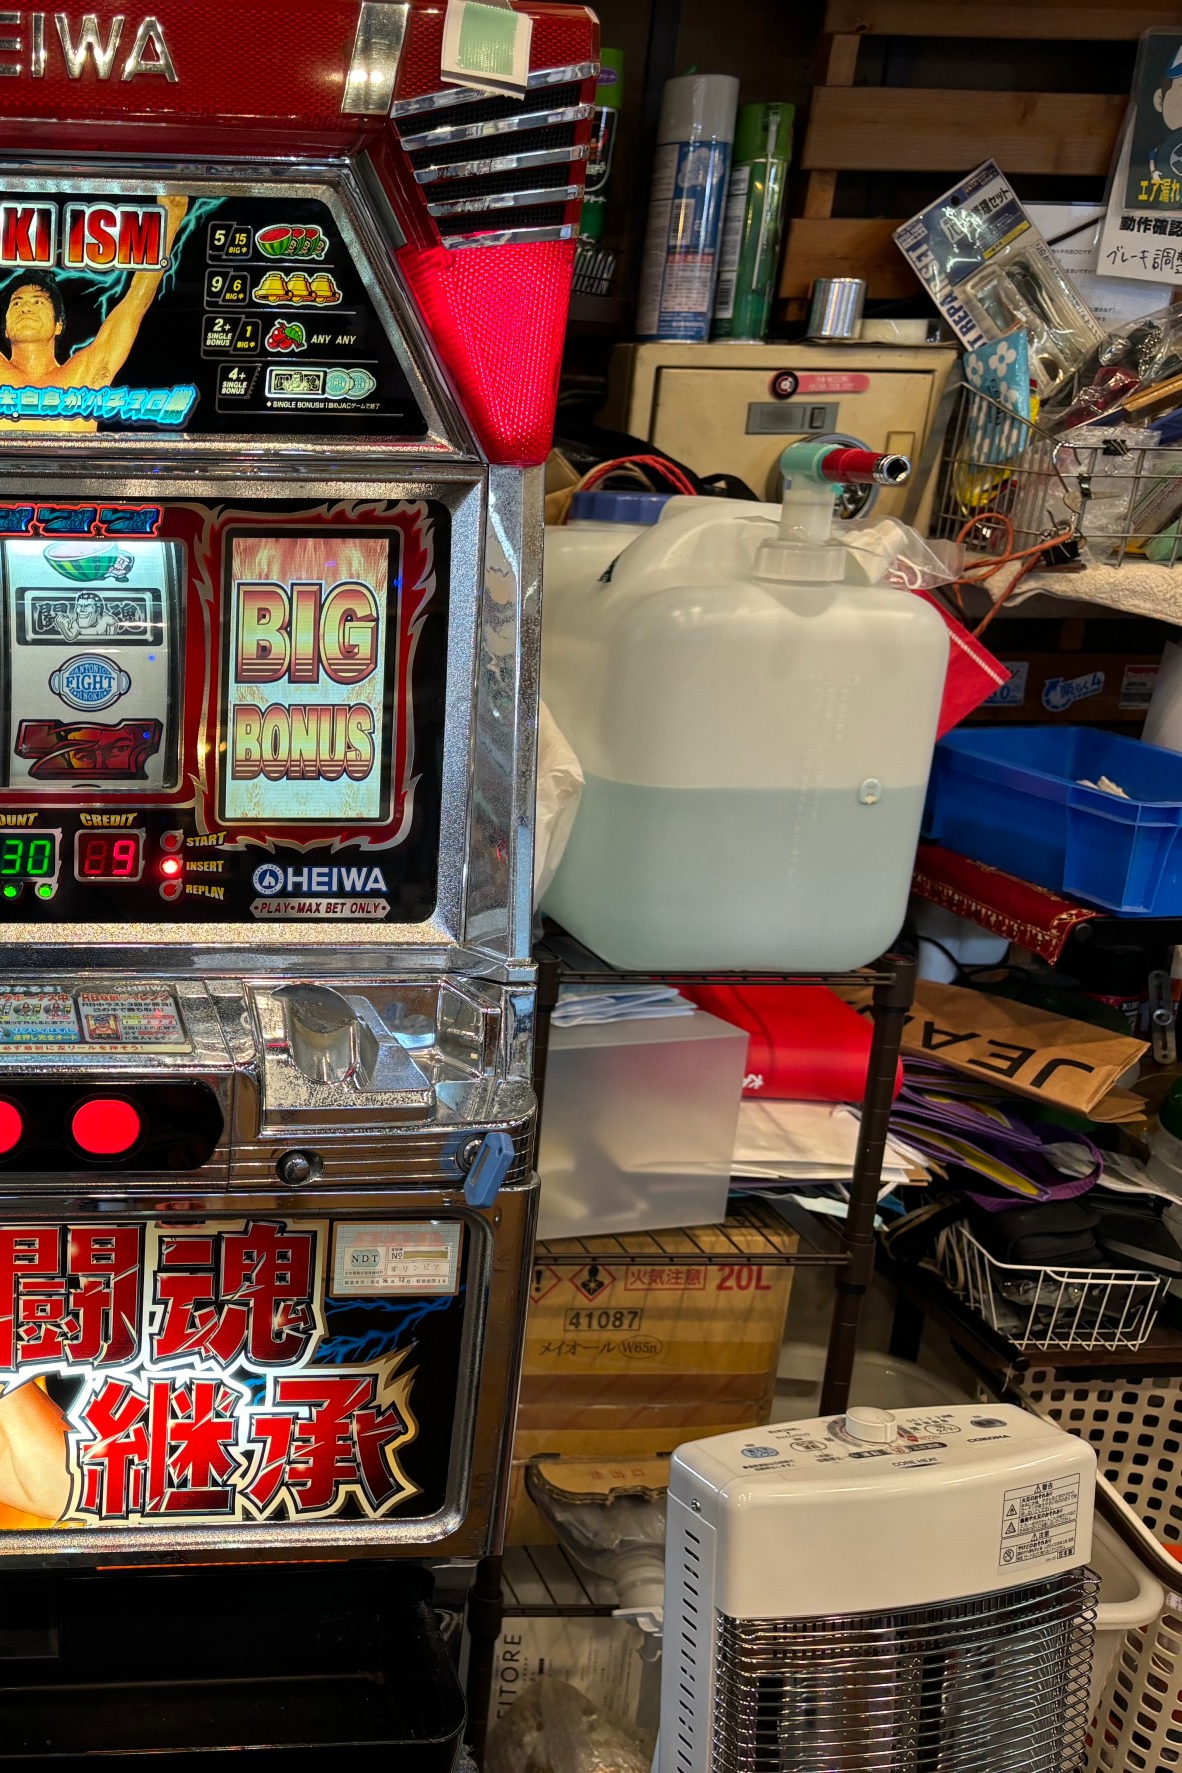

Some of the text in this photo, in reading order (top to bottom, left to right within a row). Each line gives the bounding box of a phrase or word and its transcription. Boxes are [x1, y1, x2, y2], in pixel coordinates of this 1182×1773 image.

[1138, 178, 1182, 202] エア漏れ
[68, 208, 160, 266] ISM
[214, 230, 226, 246] 5
[234, 233, 247, 245] 15
[211, 276, 223, 292] 9
[233, 280, 242, 291] 6
[245, 326, 252, 338] 1
[310, 335, 357, 344] ANY ANY
[206, 339, 230, 347] BONUS
[221, 387, 245, 395] BONUS
[222, 381, 247, 389] SINGLE
[235, 581, 379, 685] BIG
[72, 662, 110, 674] ANTONIO
[65, 674, 116, 691] FIGHT
[232, 703, 375, 781] BONUS
[80, 813, 138, 827] CREDIT
[186, 831, 227, 847] START
[1, 840, 51, 875] 30
[113, 840, 136, 875] 9
[186, 860, 224, 873] INSERT
[286, 867, 388, 892] HEIWA
[185, 884, 225, 900] REPLAY
[325, 902, 346, 914] BET
[350, 902, 380, 914] ONLY
[902, 1014, 1095, 1089] JEA
[351, 1254, 379, 1263] NDT
[629, 1268, 702, 1286] 火気注意
[716, 1265, 772, 1291] 20L
[569, 1311, 640, 1329] 41087
[538, 1340, 616, 1356] メイオール
[79, 1372, 410, 1519] 継承
[967, 1434, 1011, 1443] CORONA
